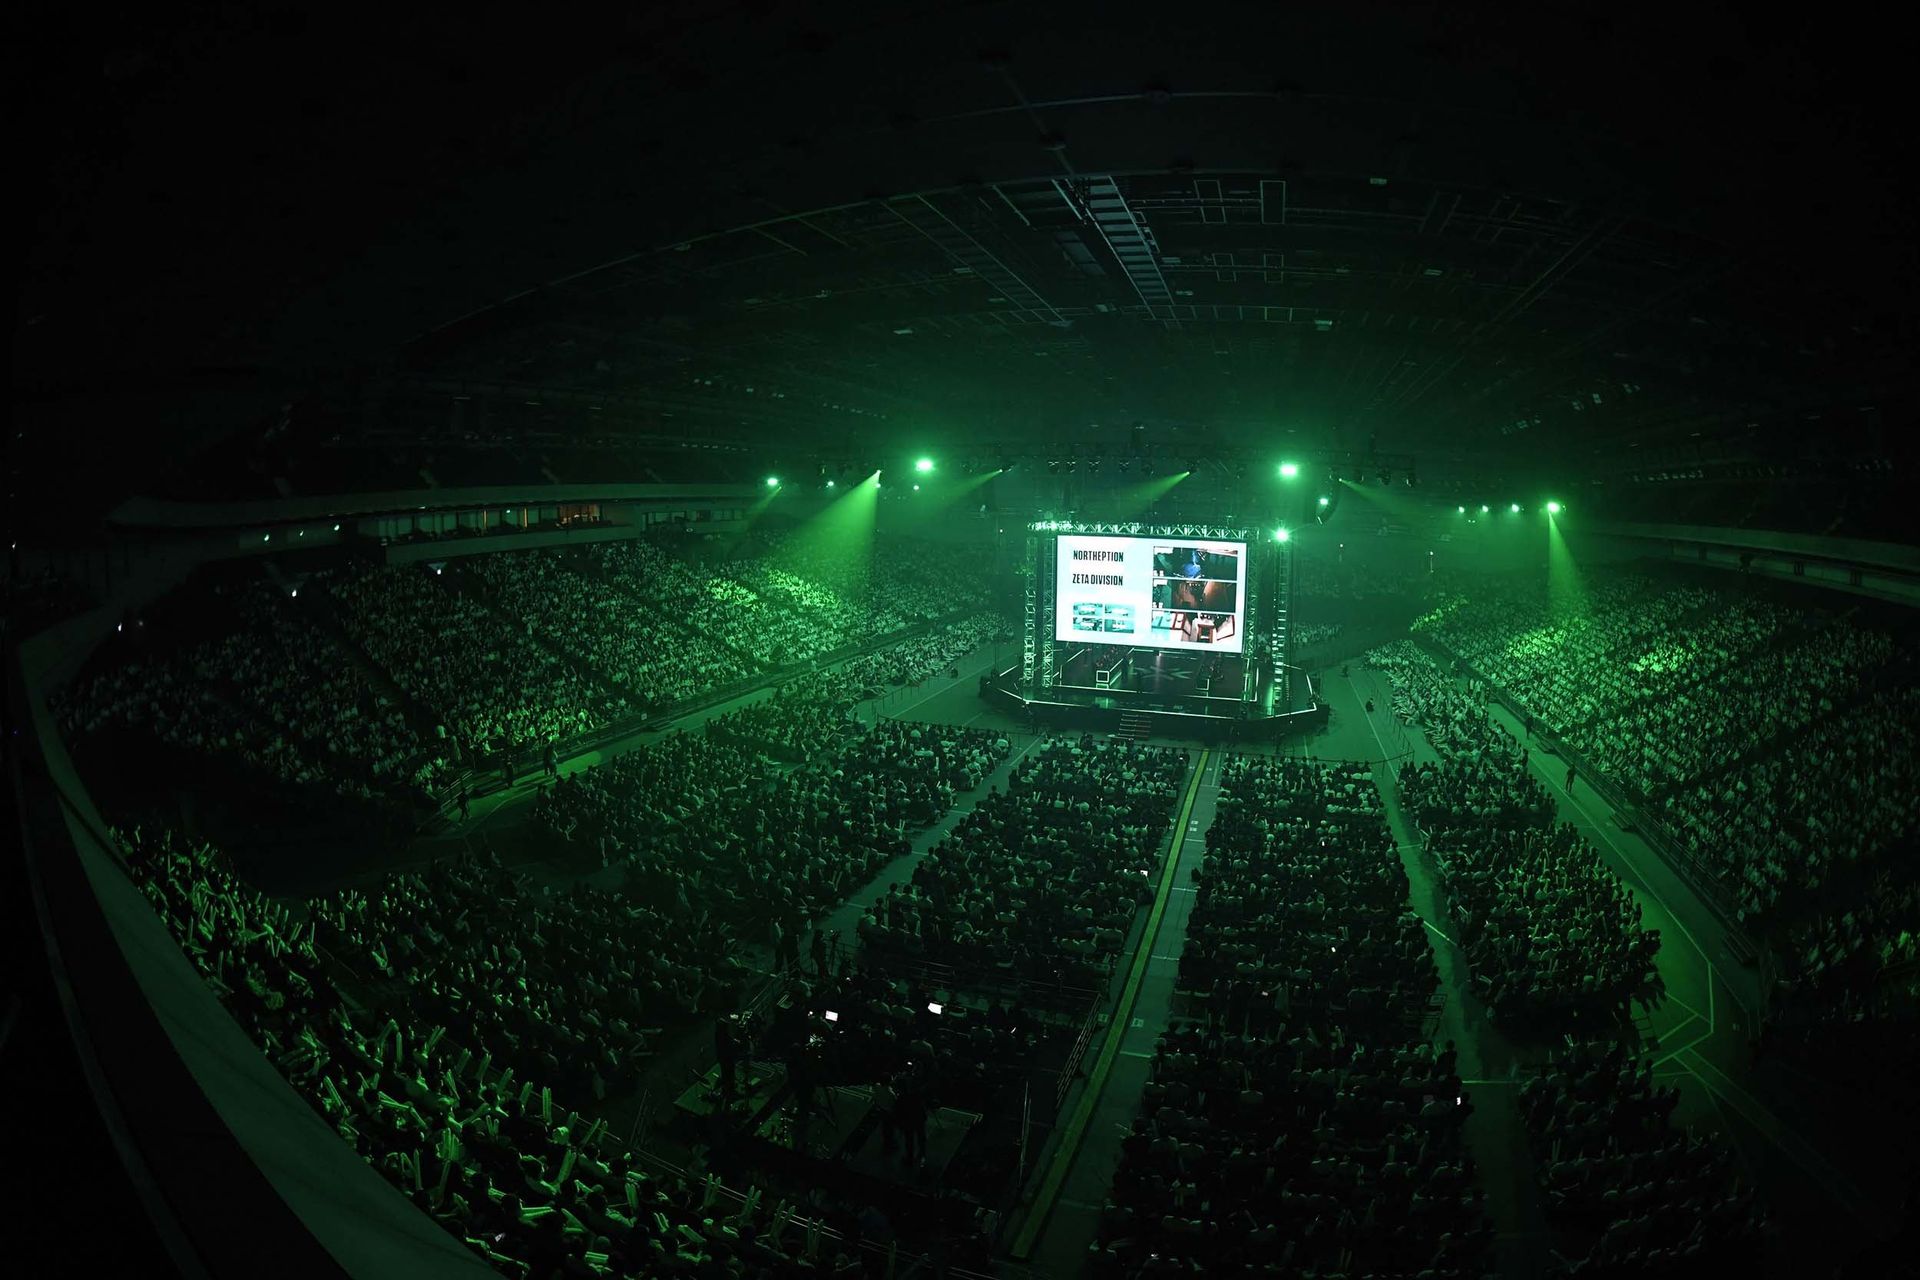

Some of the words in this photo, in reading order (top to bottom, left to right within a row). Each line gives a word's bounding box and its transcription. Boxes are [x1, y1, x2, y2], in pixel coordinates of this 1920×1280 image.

[1073, 550, 1124, 562] NORTHEPTION
[1072, 574, 1089, 584] ZETA
[1091, 574, 1123, 586] DIVISION
